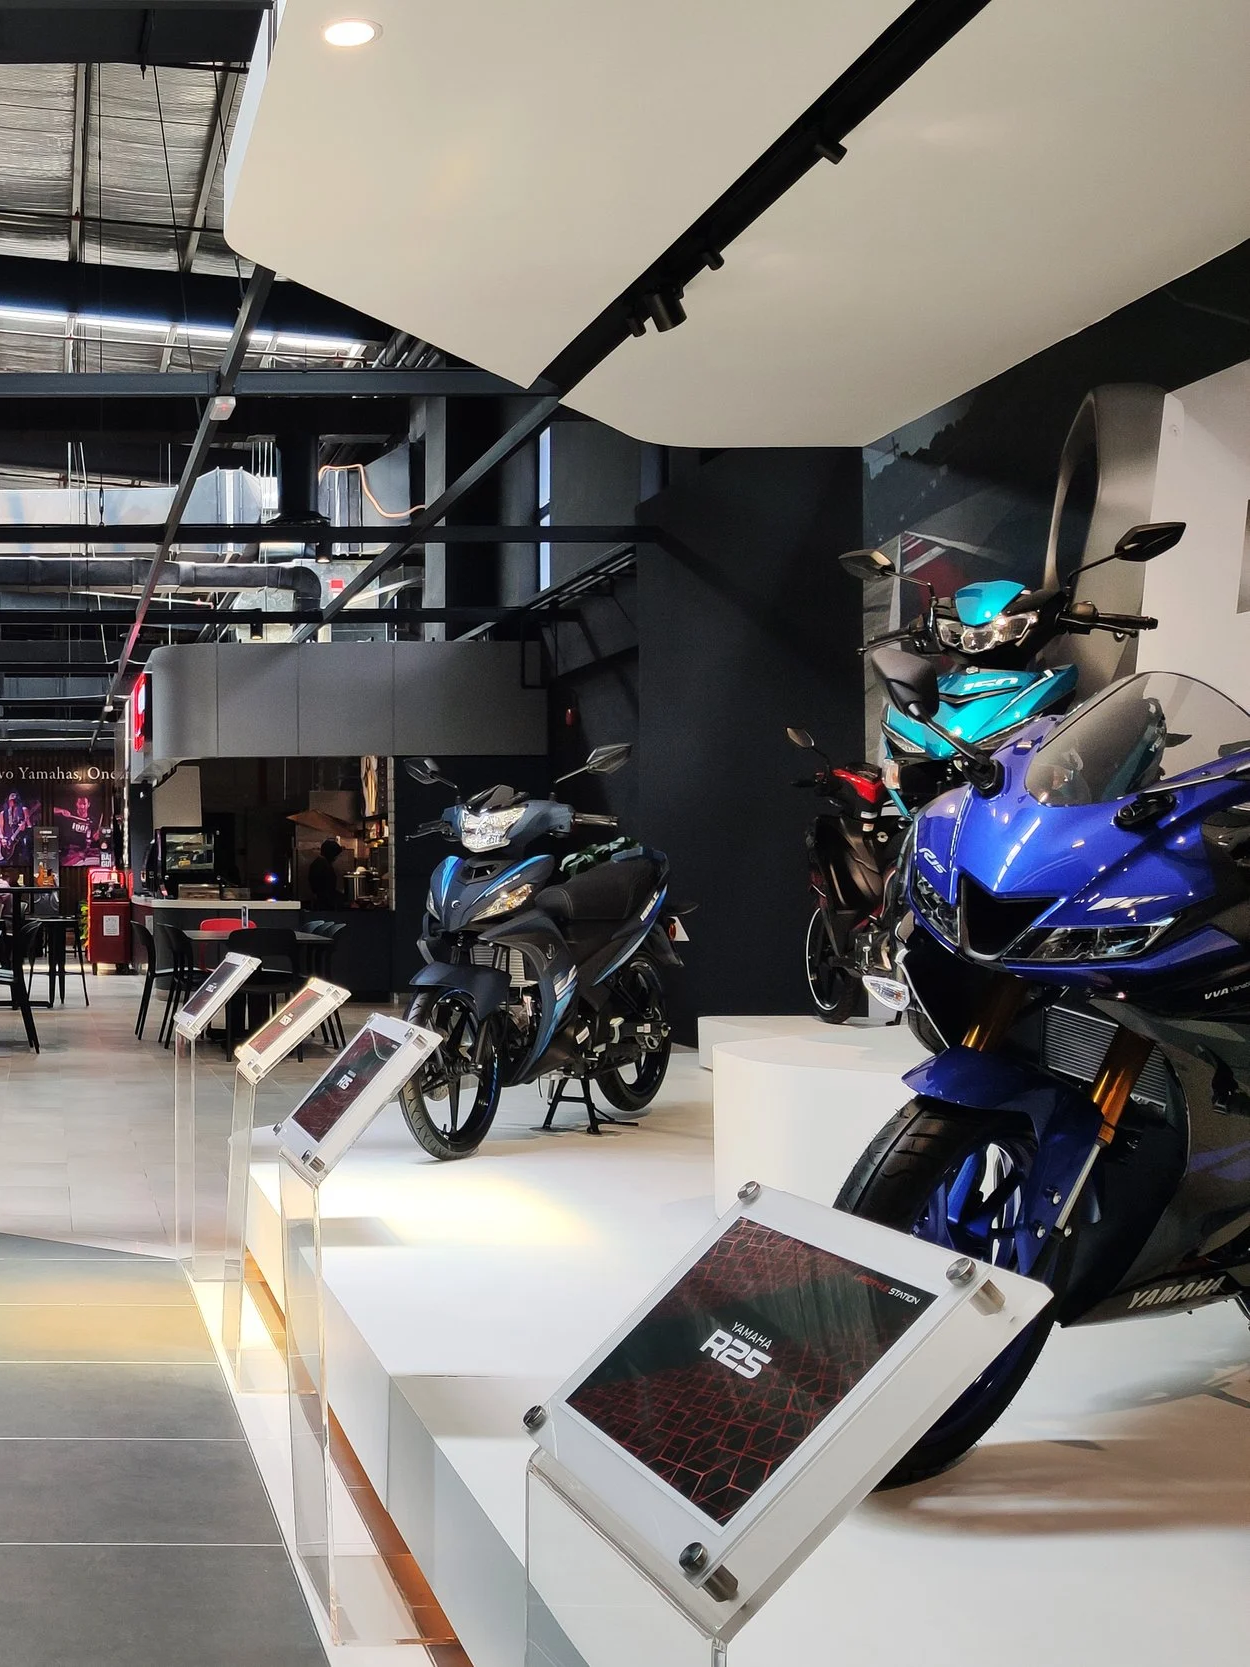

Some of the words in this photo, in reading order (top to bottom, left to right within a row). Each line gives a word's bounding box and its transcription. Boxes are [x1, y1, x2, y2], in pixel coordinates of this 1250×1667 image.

[19, 766, 82, 781] Yamahas,
[1204, 987, 1229, 1000] VVA
[888, 1287, 921, 1305] STATION
[1127, 1275, 1226, 1310] YAMAHA
[731, 1321, 773, 1350] YAMAHA
[699, 1328, 773, 1379] R25
